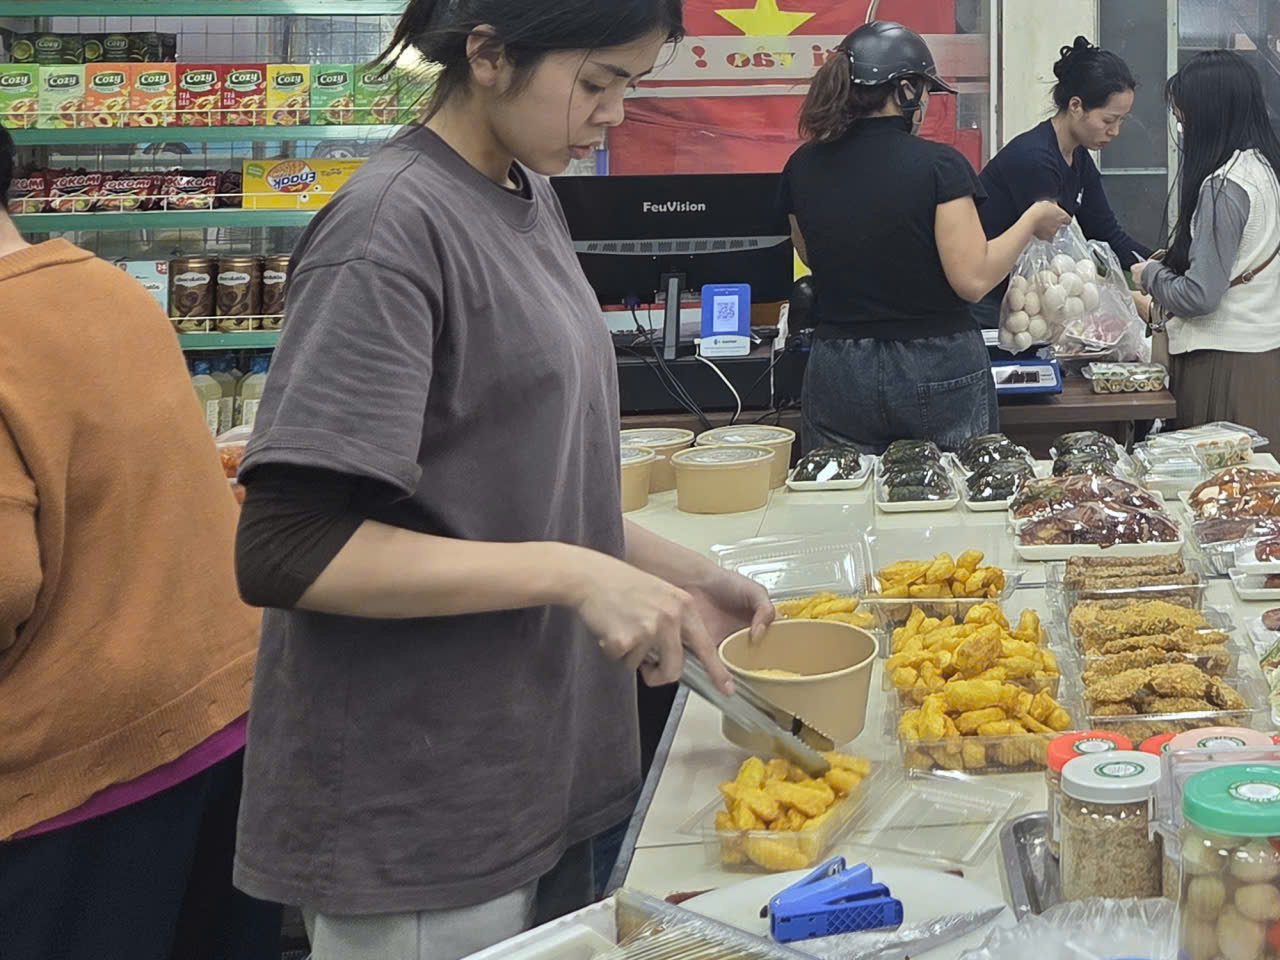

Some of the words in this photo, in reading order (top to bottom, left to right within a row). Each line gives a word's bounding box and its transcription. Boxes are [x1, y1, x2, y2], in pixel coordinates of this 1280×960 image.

[1, 75, 28, 84] Cozy
[50, 76, 76, 86] Cozy
[95, 74, 121, 84] Cozy
[141, 74, 166, 83] Cozy
[186, 73, 213, 83] Cozy
[231, 73, 258, 83] Cozy
[277, 75, 301, 84] Cozy
[319, 74, 344, 83] Cozy
[51, 174, 101, 188] KOKOMI
[273, 171, 316, 188] Enaak
[643, 201, 706, 212] FeuVision
